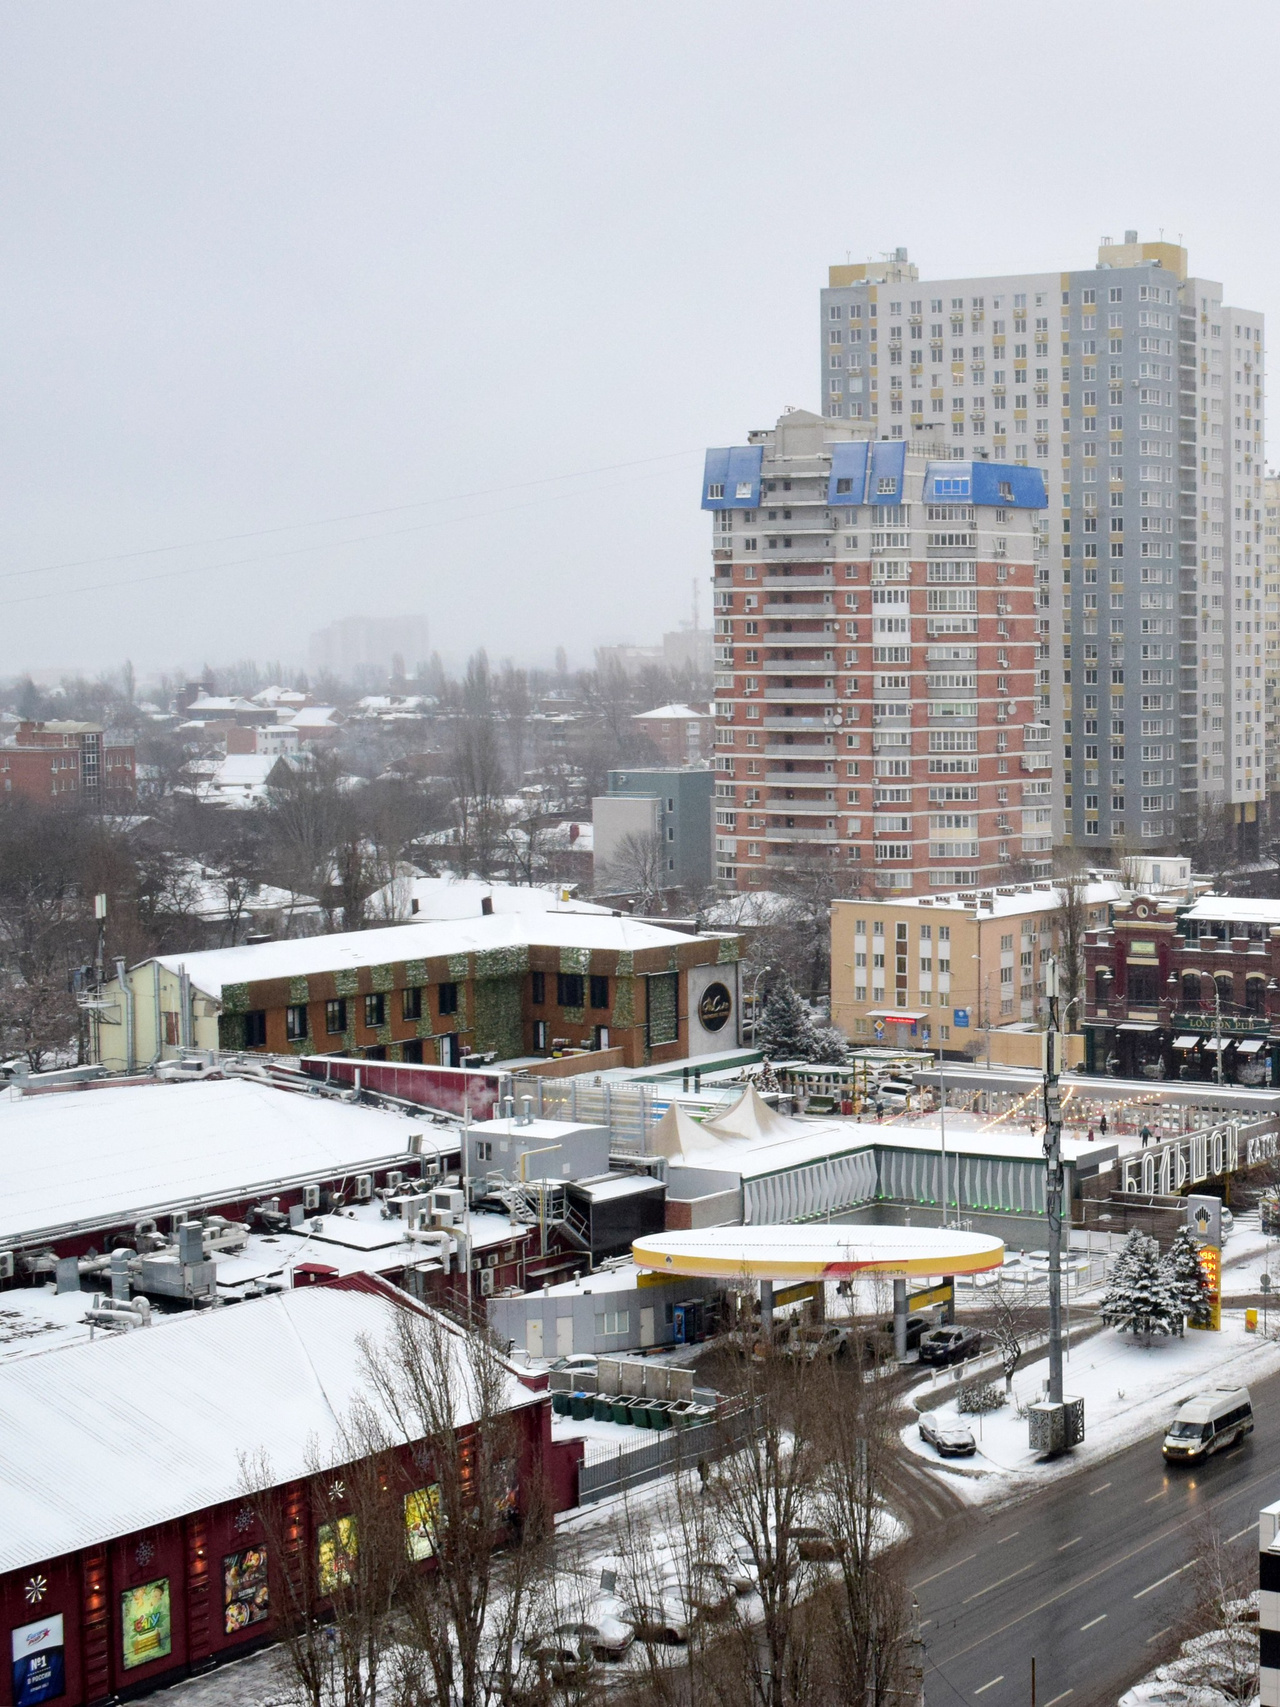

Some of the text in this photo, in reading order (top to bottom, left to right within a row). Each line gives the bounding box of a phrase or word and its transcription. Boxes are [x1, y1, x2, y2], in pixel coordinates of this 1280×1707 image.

[1190, 1019, 1255, 1030] LONDON PUB
[1122, 1121, 1279, 1195] БОЛЬШОЙ КАТОК
[30, 1655, 47, 1671] №1
